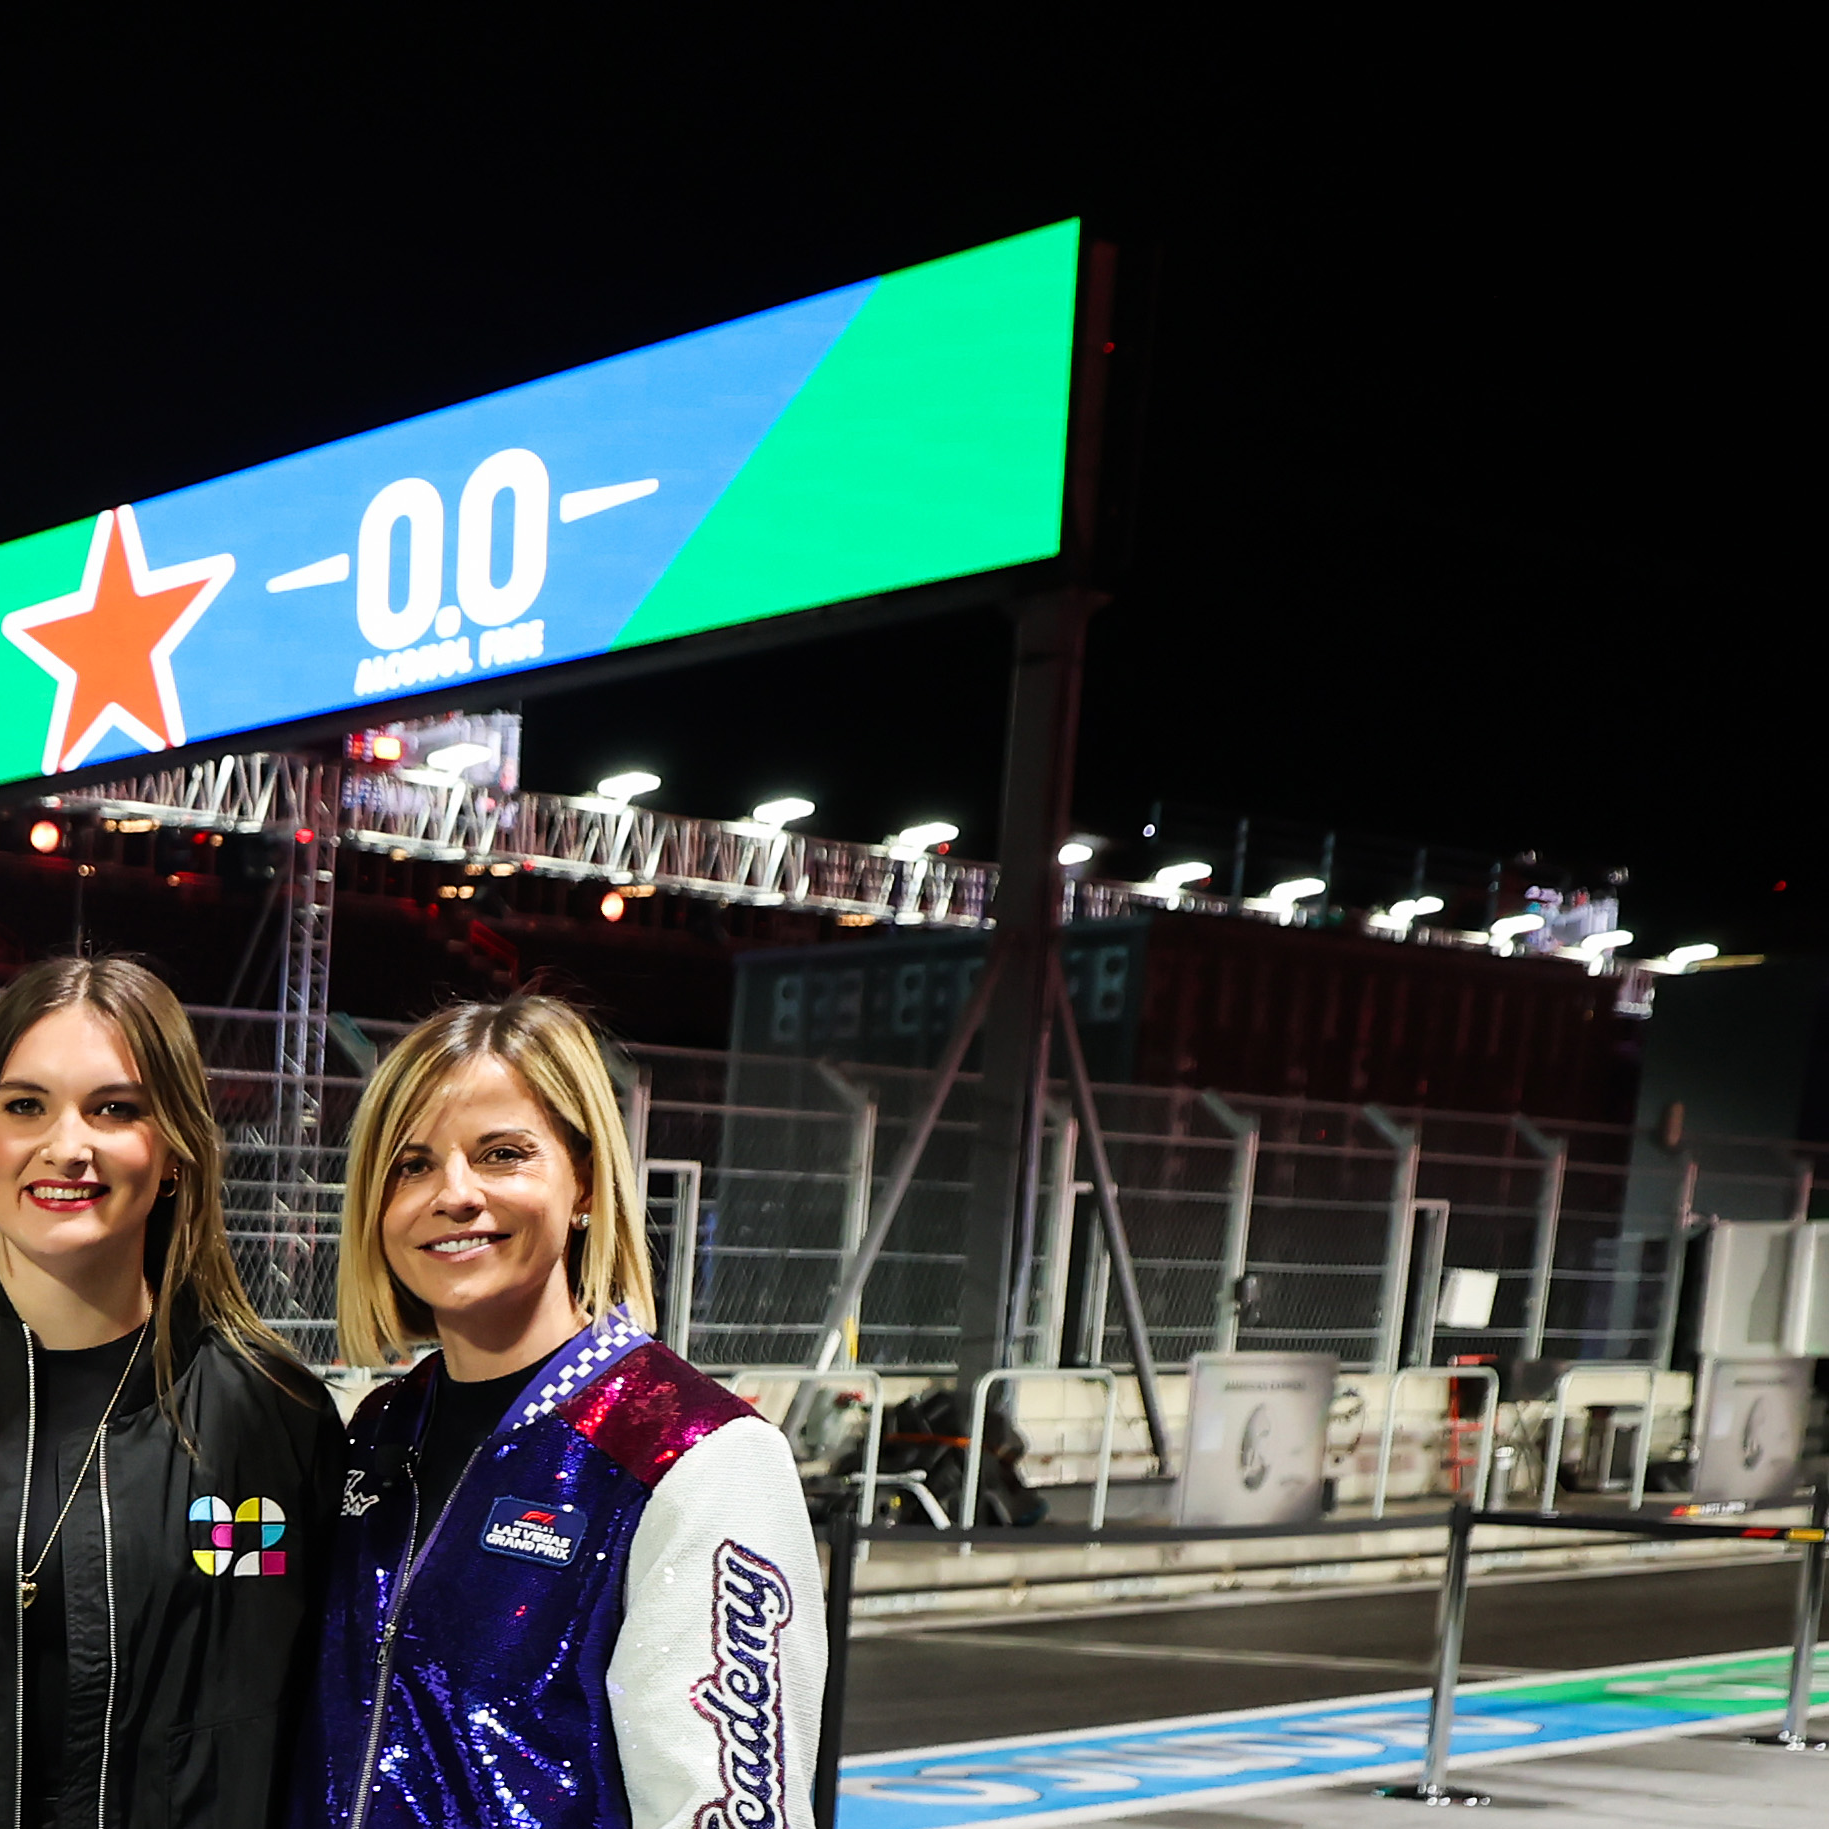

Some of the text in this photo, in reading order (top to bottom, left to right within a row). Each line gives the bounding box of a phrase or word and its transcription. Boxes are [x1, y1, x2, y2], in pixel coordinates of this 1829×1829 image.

[485, 1532, 571, 1561] GRAND PRIX
[492, 1523, 572, 1549] LAS VEGAS
